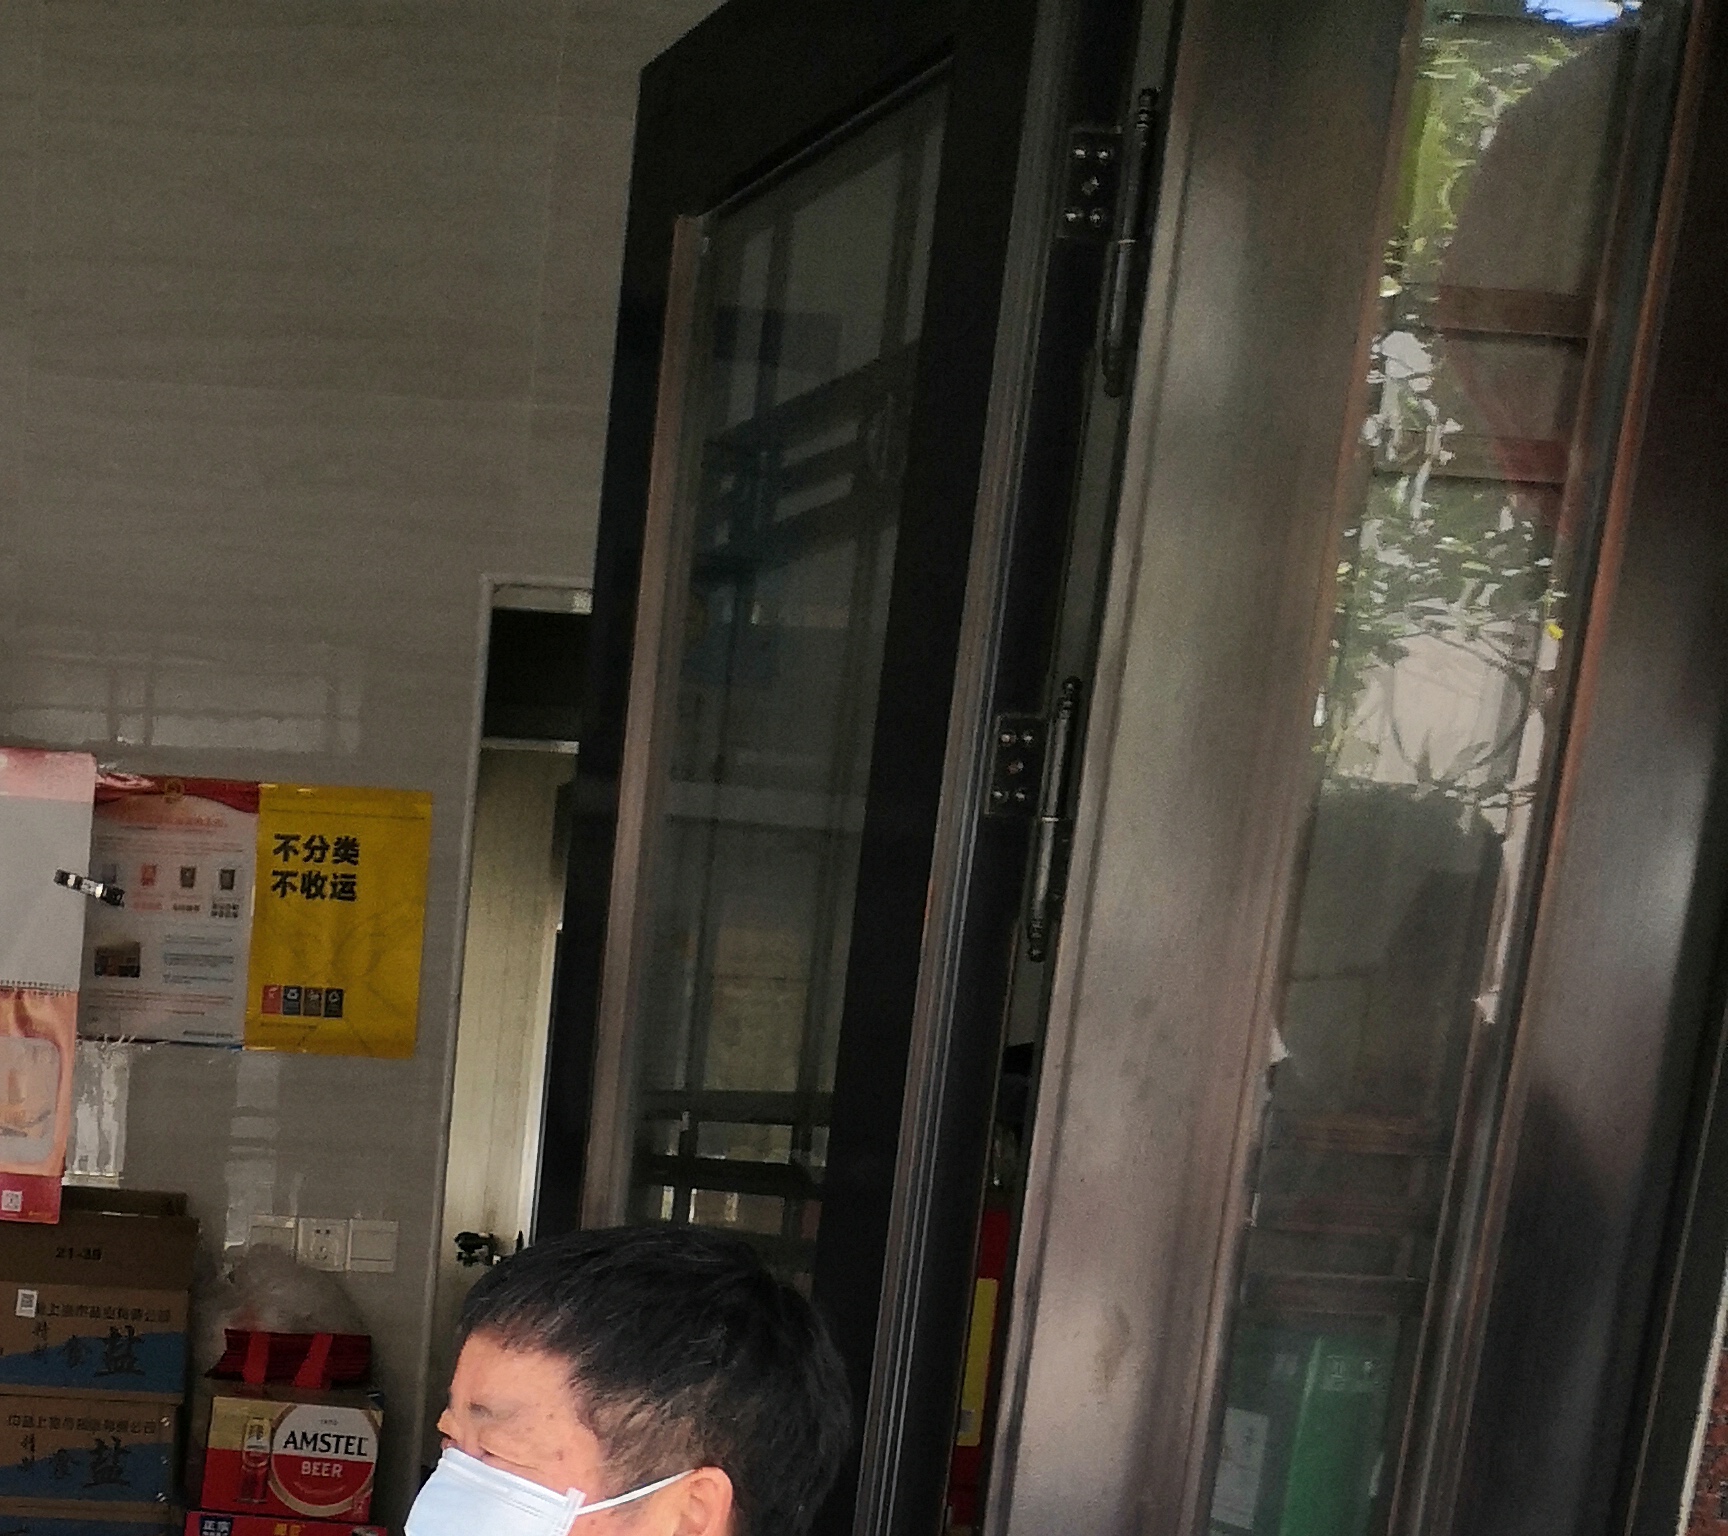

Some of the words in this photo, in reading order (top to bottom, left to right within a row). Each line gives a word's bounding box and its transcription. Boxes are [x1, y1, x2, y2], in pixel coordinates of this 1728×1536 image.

[273, 834, 359, 864] 不分类
[271, 870, 356, 901] 不收运
[283, 1430, 368, 1456] AMSTEL
[301, 1460, 343, 1478] BEER
